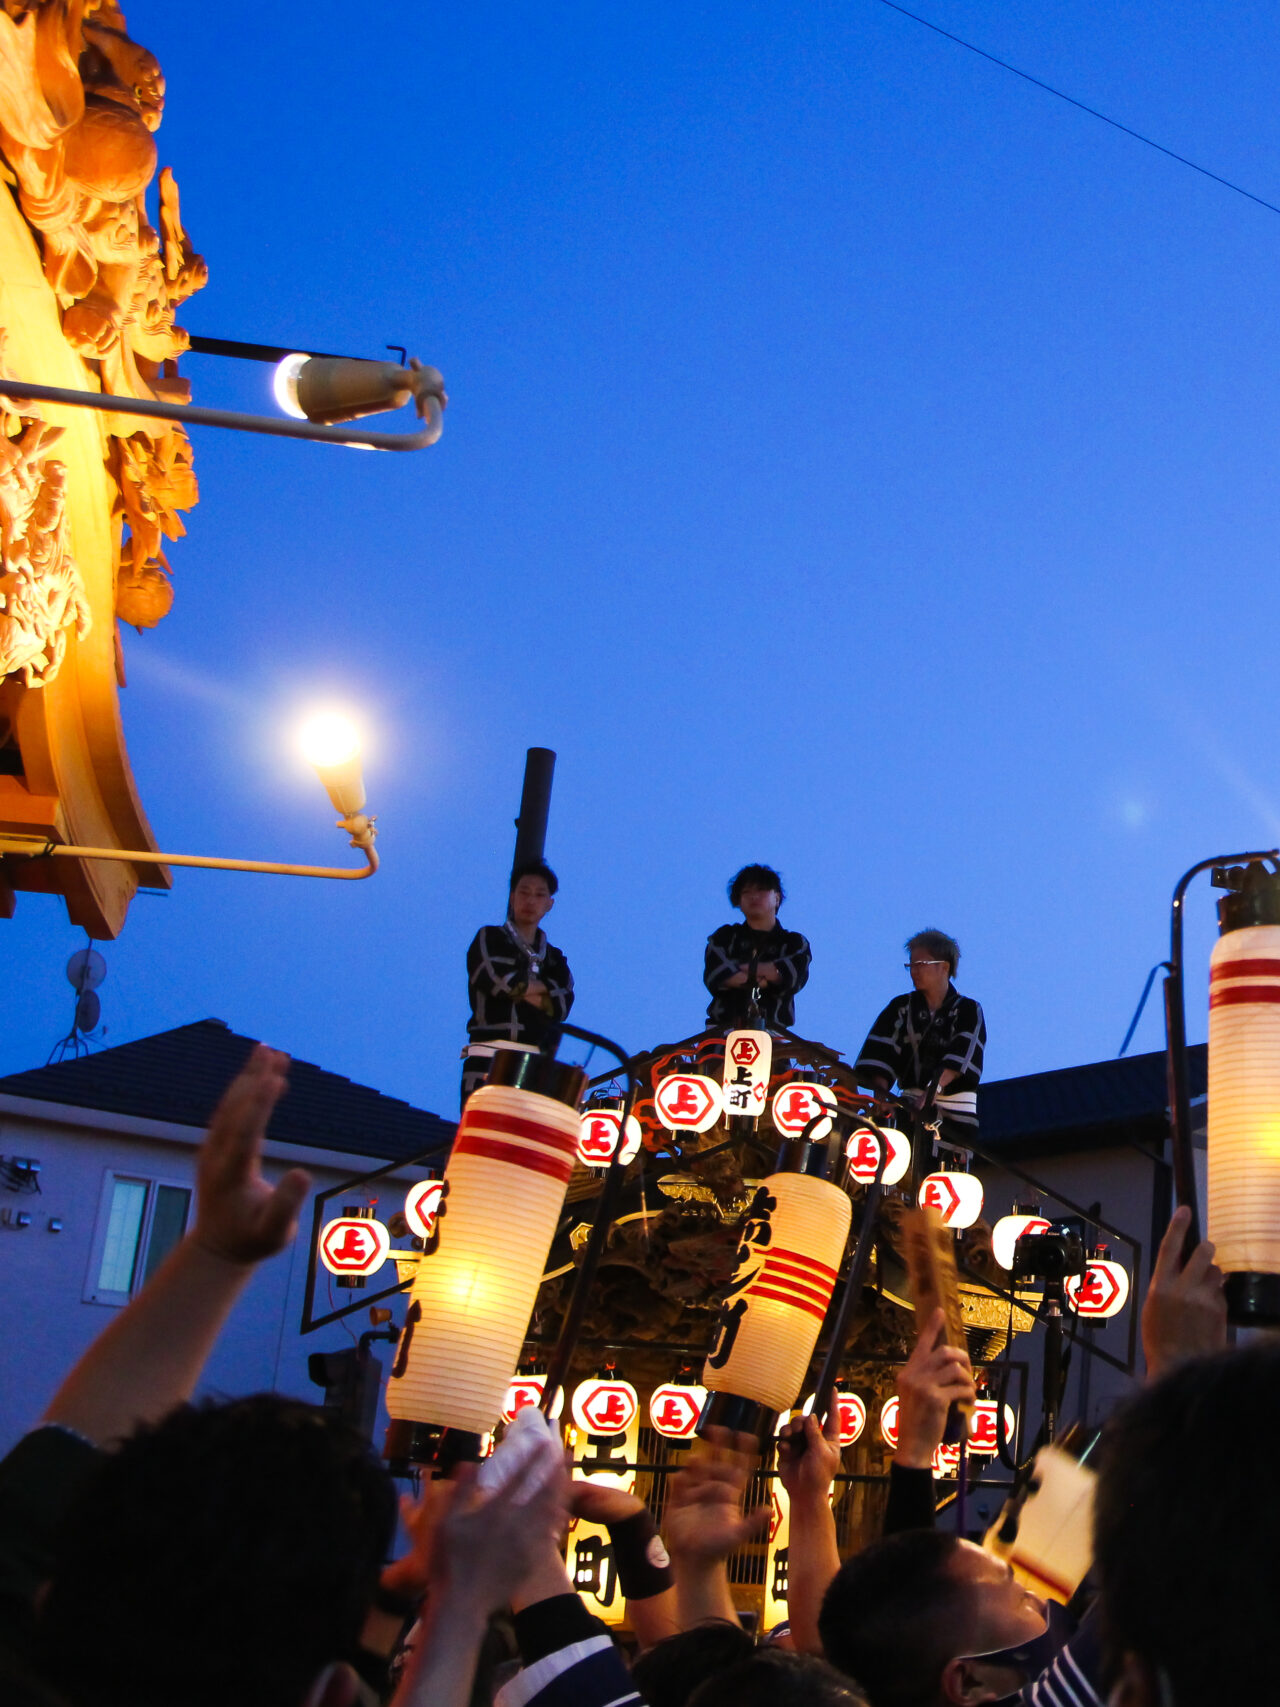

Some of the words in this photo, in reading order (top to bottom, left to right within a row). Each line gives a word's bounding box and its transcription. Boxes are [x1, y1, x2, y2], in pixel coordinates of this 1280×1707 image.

[667, 1084, 699, 1116] 上
[334, 1228, 368, 1261] 上
[595, 1394, 626, 1425] 上
[656, 1399, 683, 1429] 上
